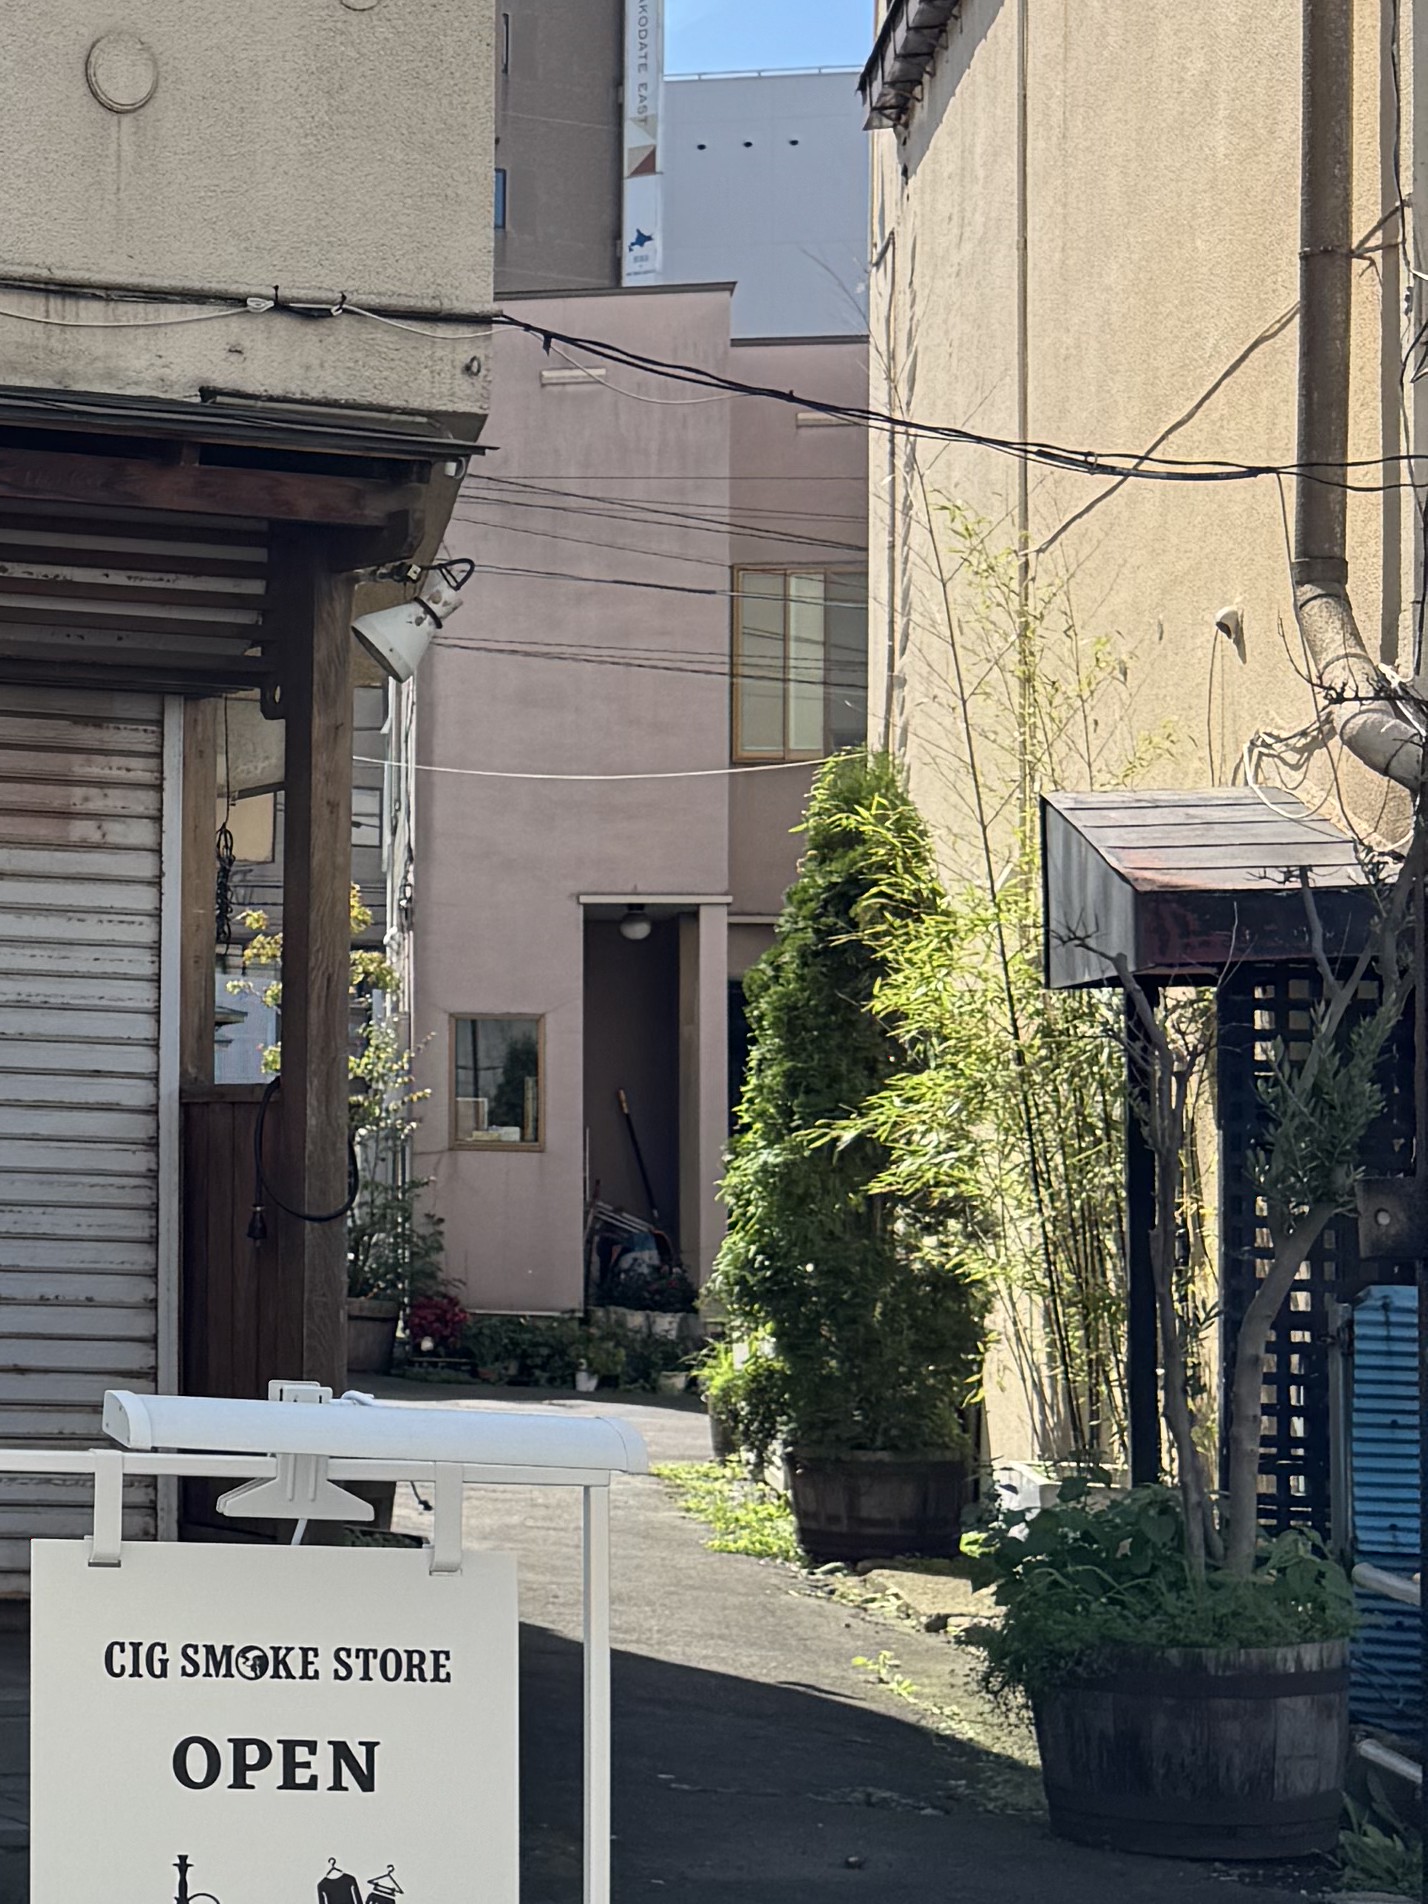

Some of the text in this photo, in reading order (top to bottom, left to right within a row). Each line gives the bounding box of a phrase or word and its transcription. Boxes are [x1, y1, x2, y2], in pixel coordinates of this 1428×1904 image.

[636, 81, 649, 126] EAST
[104, 1640, 452, 1684] CIG SMOKE STORE
[172, 1735, 381, 1793] OPEN
